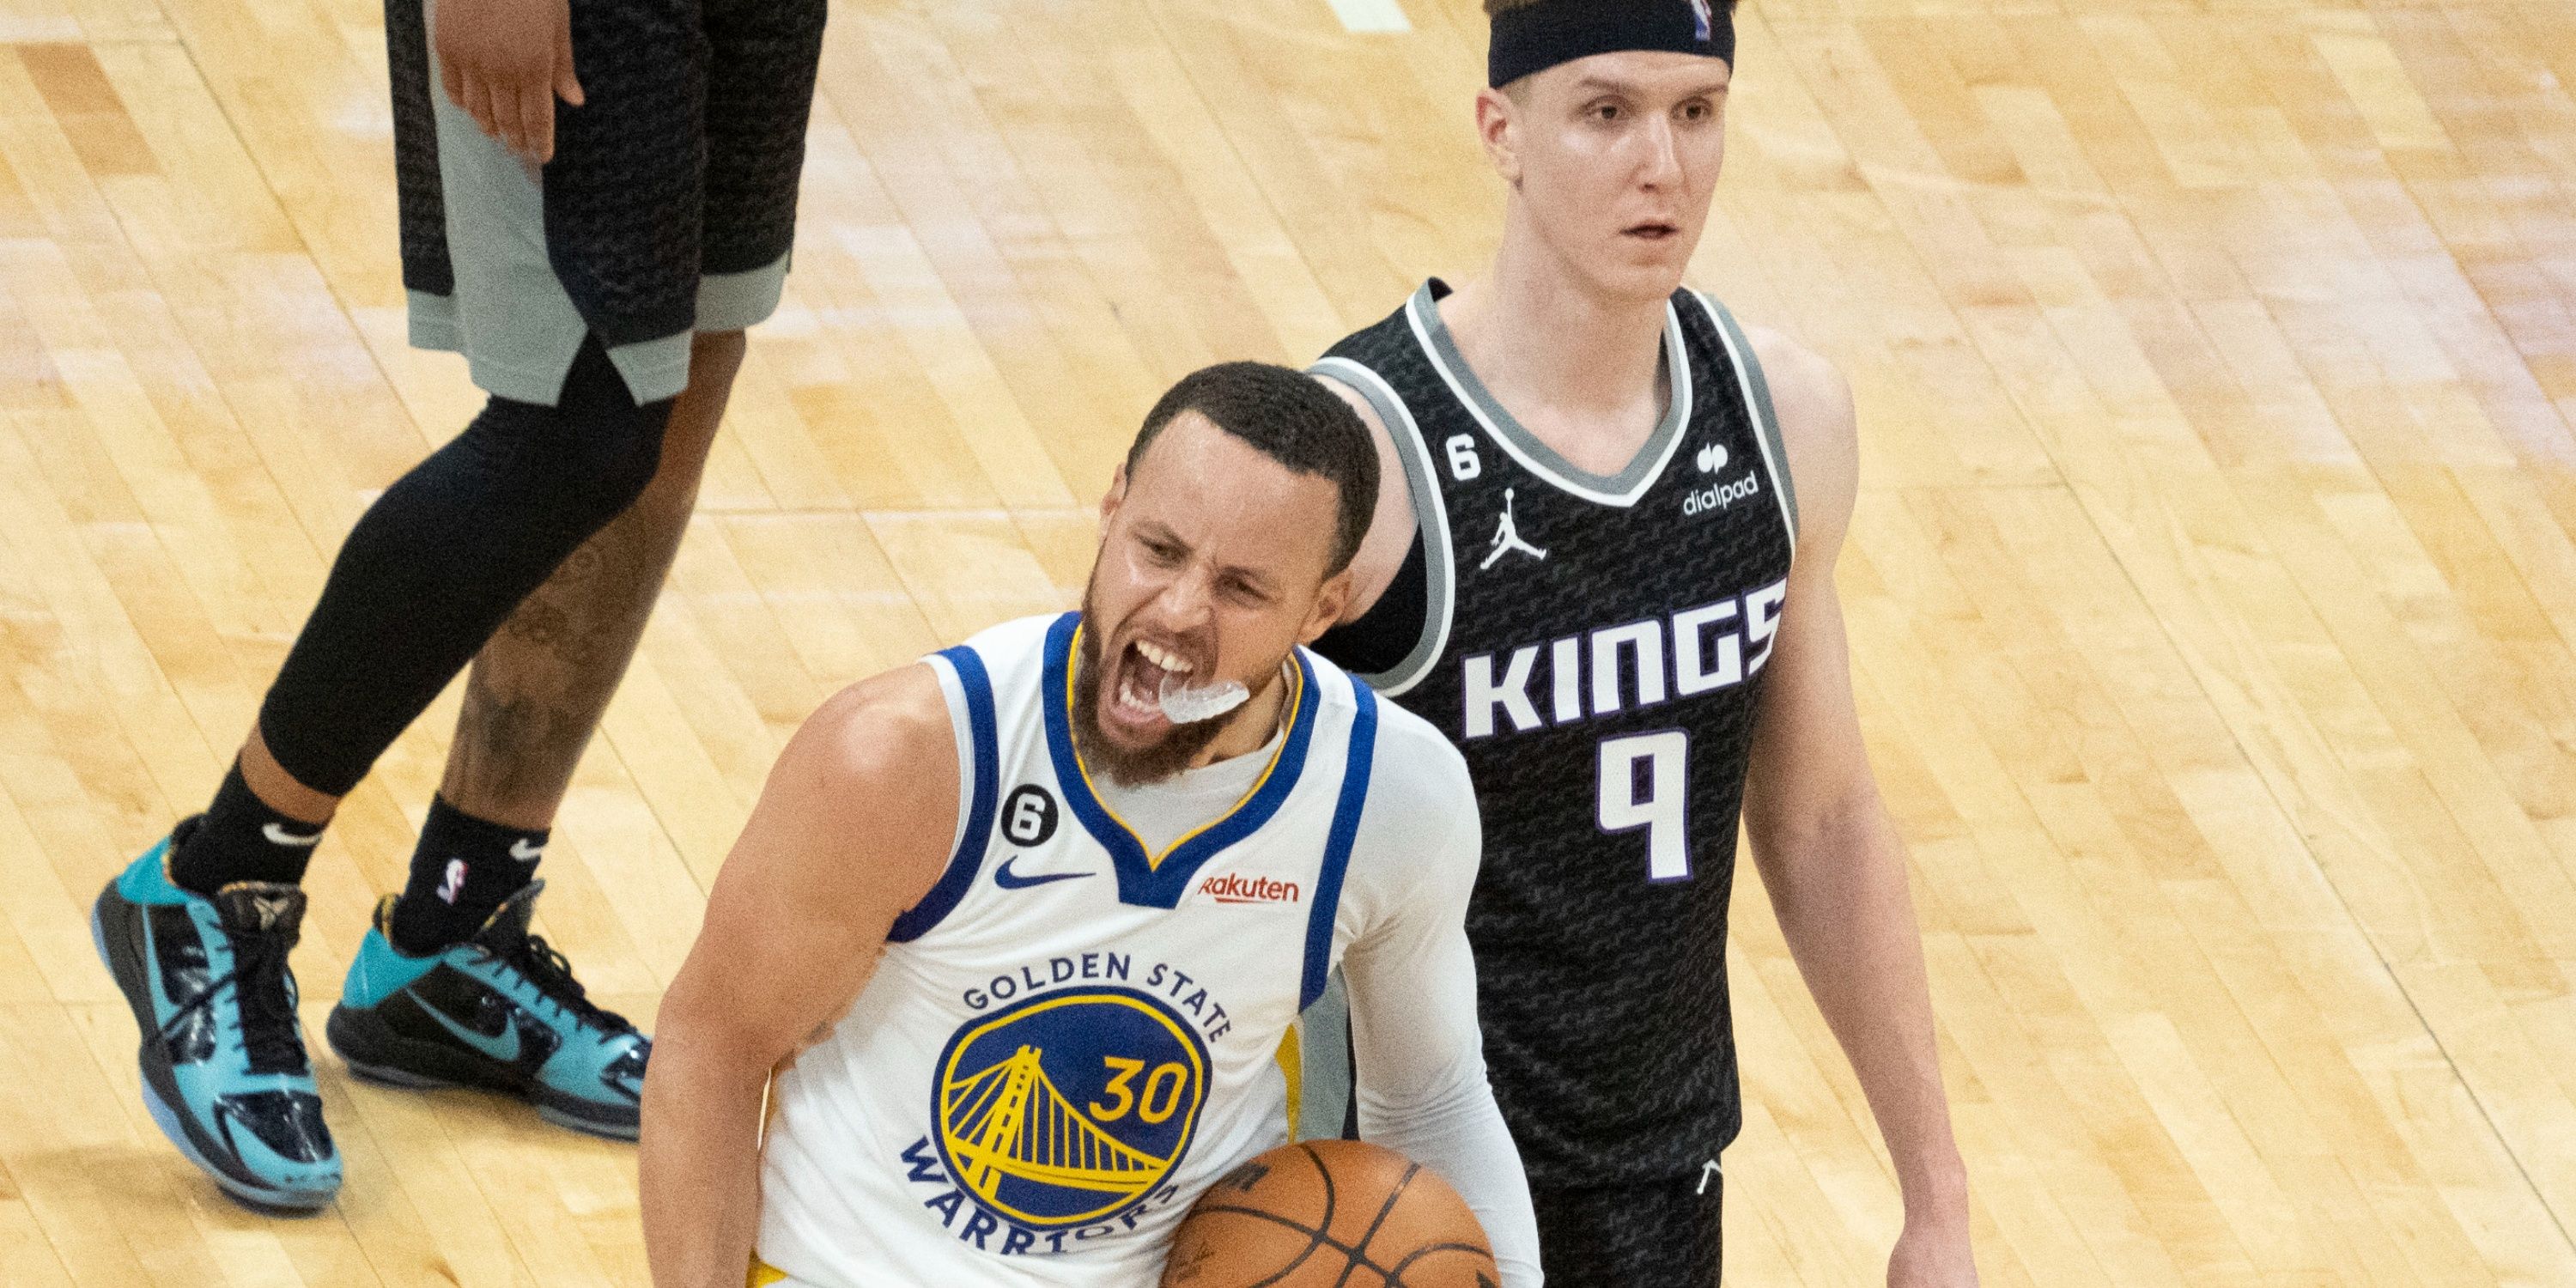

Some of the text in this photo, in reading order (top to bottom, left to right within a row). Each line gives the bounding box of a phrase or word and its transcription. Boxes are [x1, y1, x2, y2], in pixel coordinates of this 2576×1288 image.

[1445, 433, 1482, 481] 6
[1683, 470, 1759, 515] dialpad
[1462, 576, 1788, 739] KINGS
[1010, 793, 1042, 839] 6
[1597, 726, 1692, 882] 9
[1197, 872, 1299, 902] Rakuten
[963, 951, 1231, 1043] GOLDEN STATE
[1089, 1055, 1188, 1124] 30
